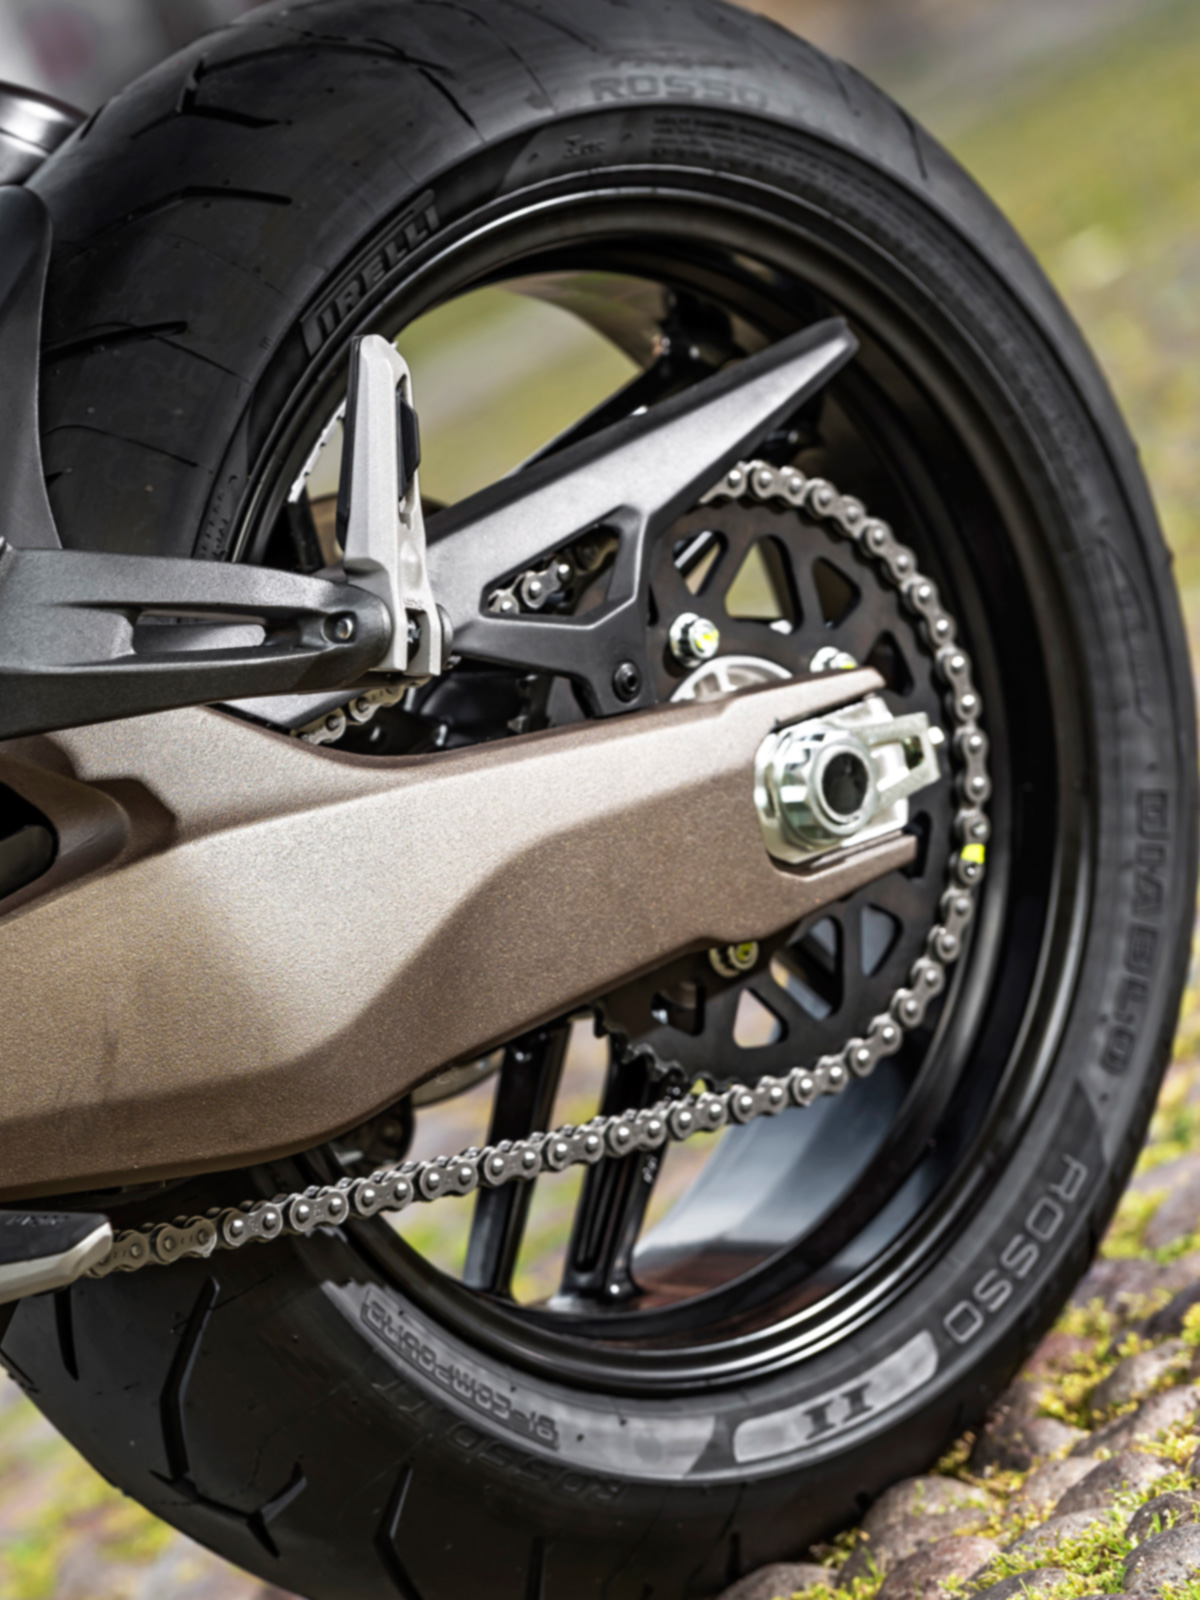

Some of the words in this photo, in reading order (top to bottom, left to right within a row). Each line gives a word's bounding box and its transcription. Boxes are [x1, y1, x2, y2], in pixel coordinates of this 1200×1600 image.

[589, 73, 768, 109] ROSSO
[1102, 787, 1170, 1076] DIABLO
[943, 1153, 1088, 1344] ROSSO
[802, 1378, 876, 1441] II
